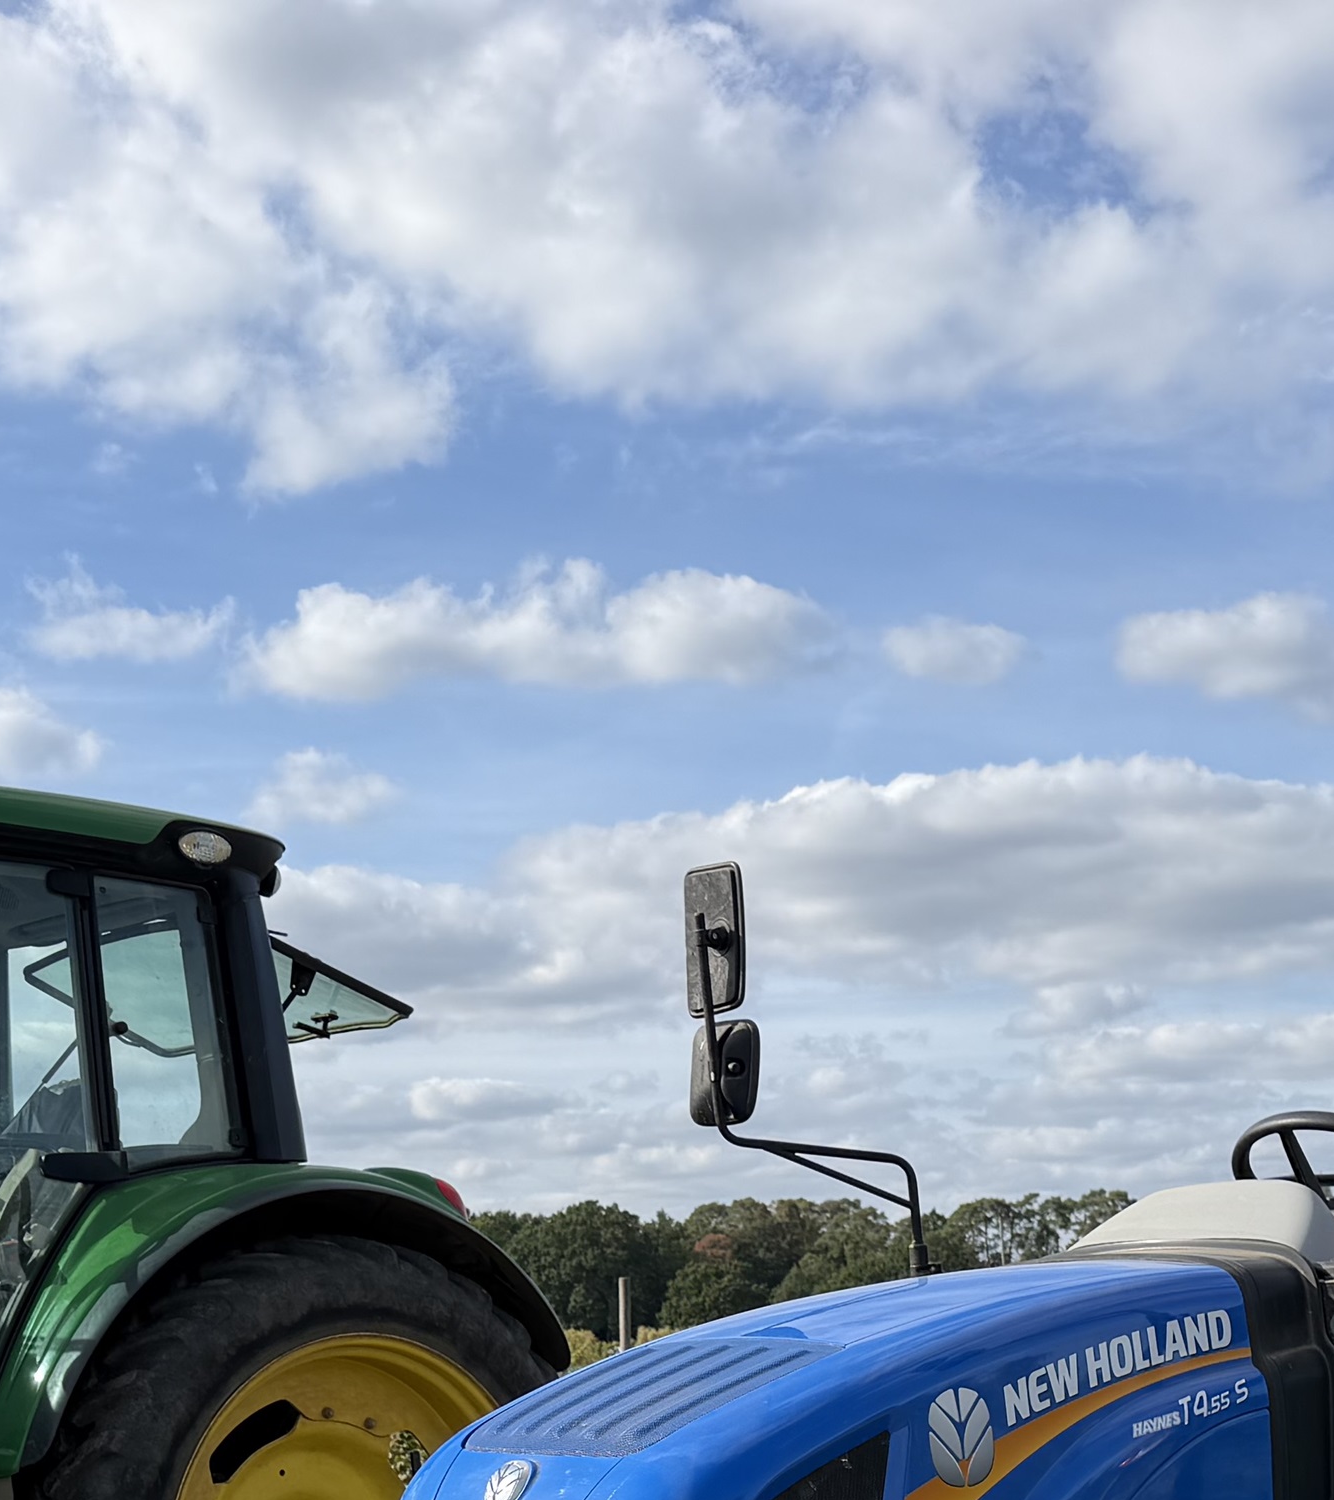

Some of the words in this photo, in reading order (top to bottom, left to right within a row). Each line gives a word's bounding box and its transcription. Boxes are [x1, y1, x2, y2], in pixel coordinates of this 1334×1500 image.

[1003, 1353, 1079, 1427] NEW
[1085, 1309, 1232, 1388] HOLLAND
[1132, 1411, 1181, 1438] HAYNES
[1234, 1378, 1248, 1404] S
